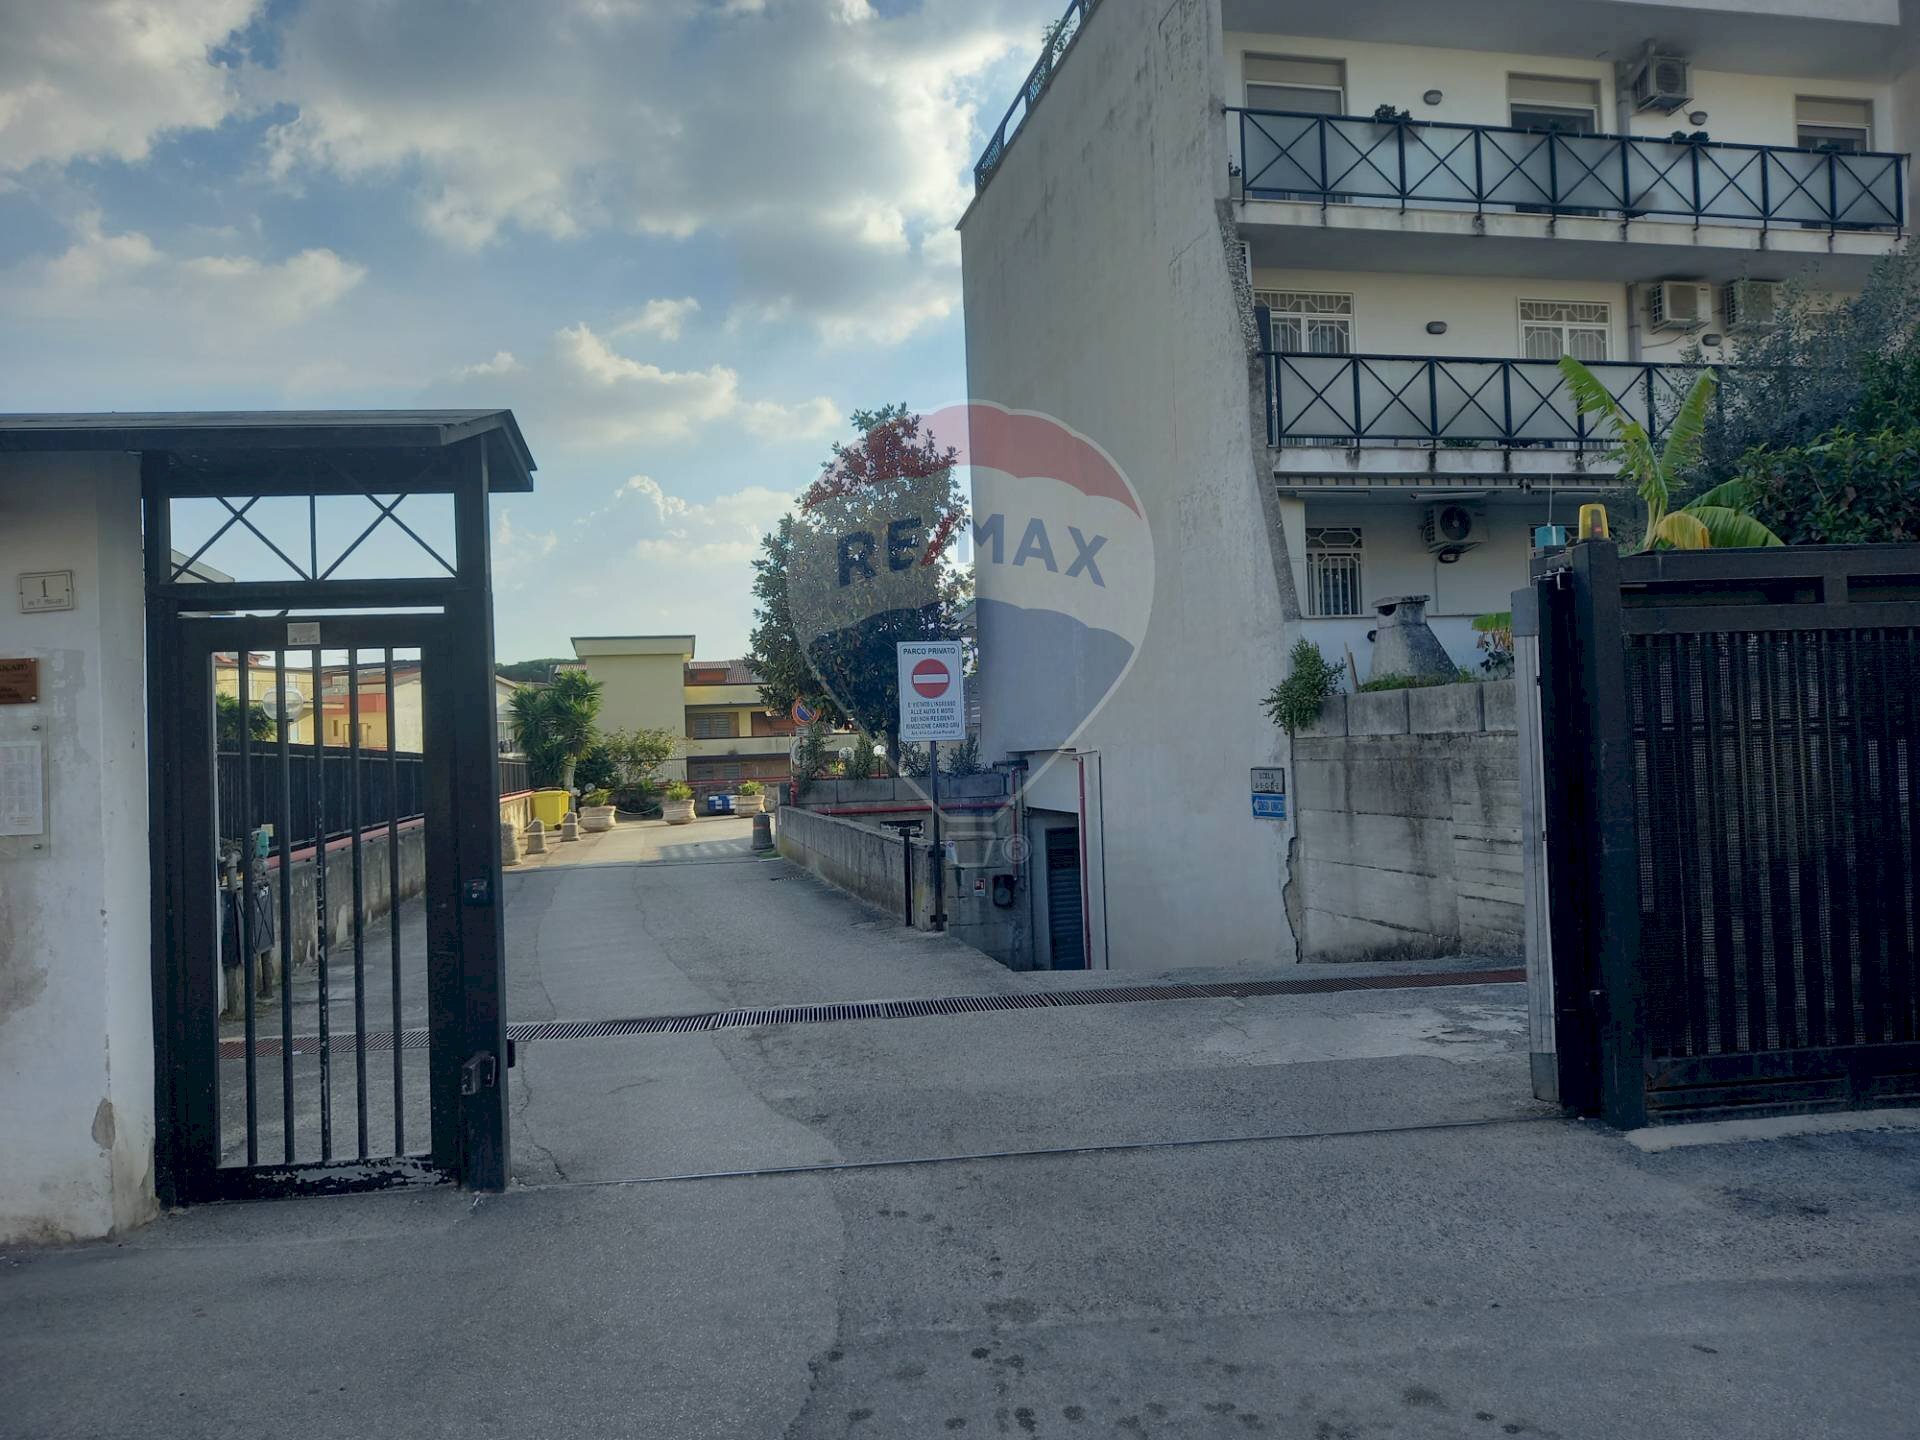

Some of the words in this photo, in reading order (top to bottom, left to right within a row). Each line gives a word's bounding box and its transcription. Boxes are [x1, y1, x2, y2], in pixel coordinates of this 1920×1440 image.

[40, 578, 48, 597] 1
[903, 647, 927, 655] PARCO
[927, 647, 956, 655] PRIVATO
